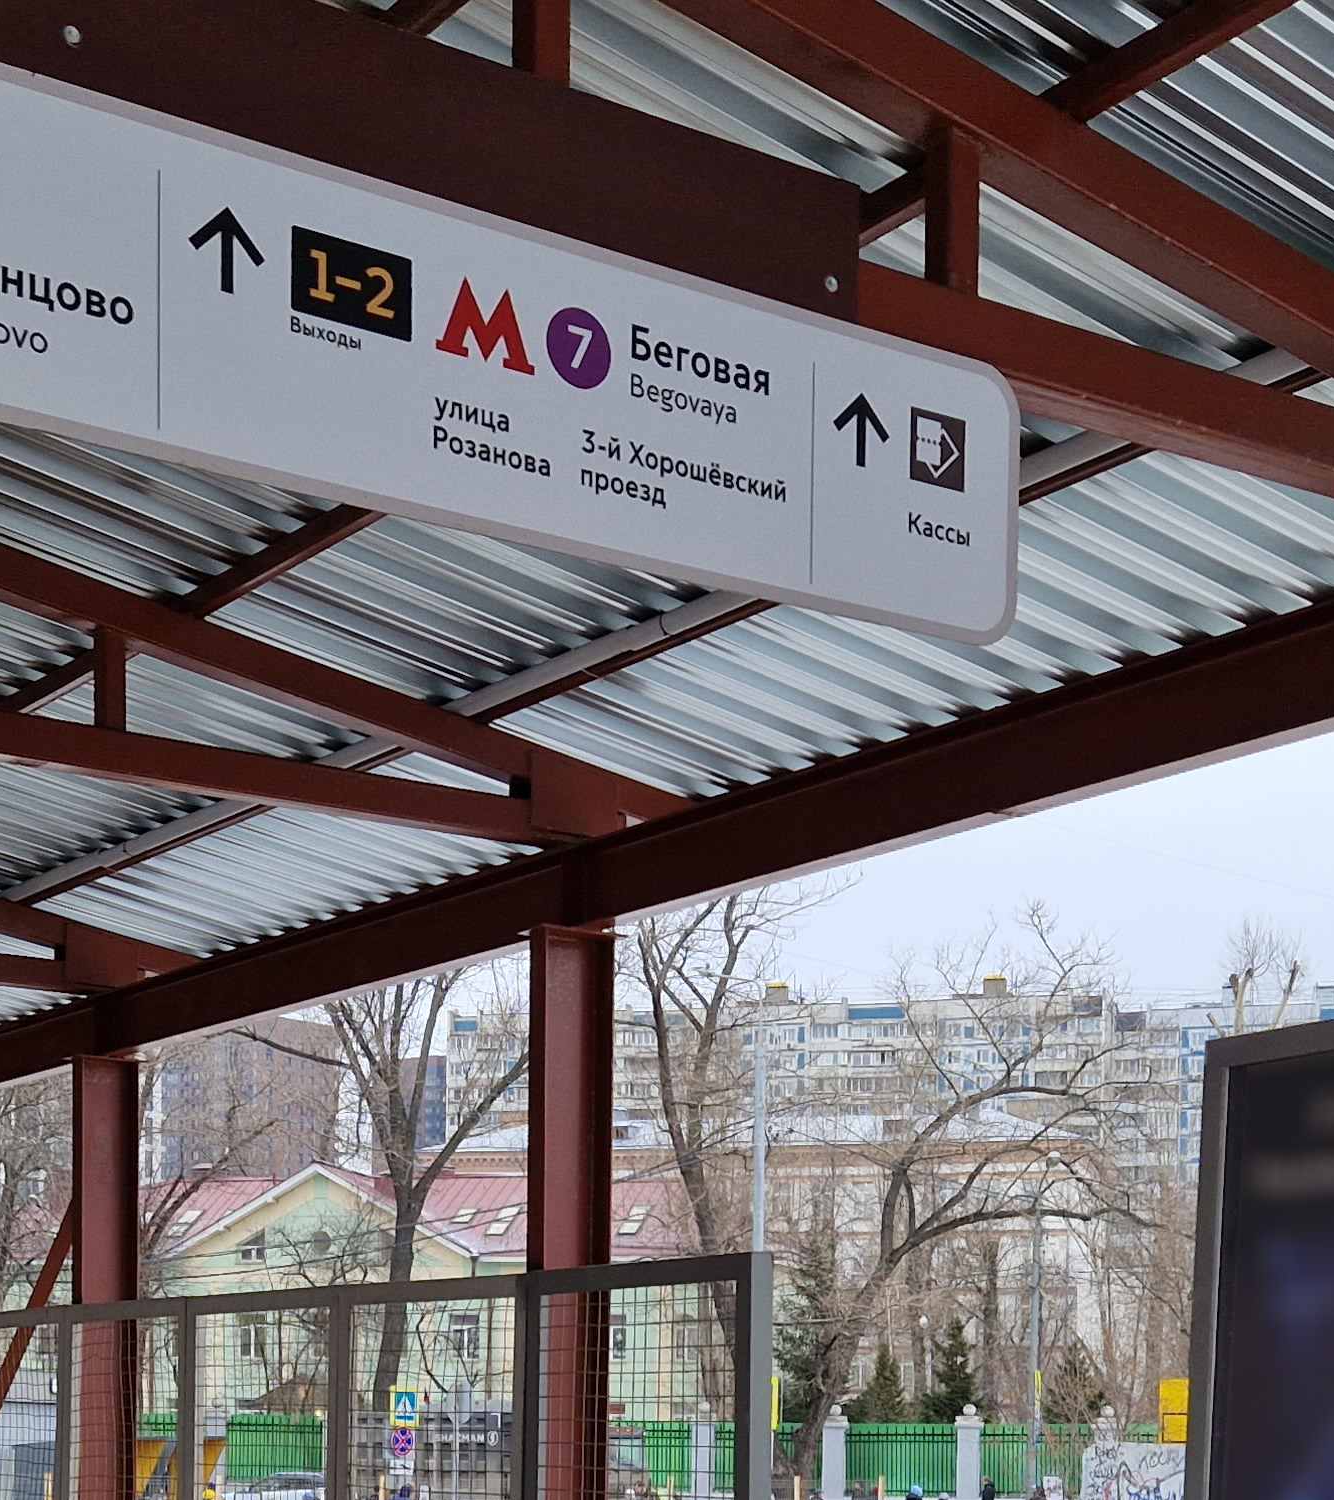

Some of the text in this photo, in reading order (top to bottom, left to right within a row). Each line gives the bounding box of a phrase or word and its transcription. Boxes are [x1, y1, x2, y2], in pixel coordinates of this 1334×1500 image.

[308, 248, 396, 320] 1-2
[290, 314, 362, 351] Выходы
[566, 324, 594, 369] 7
[630, 323, 770, 397] Беговая
[433, 396, 510, 434] улица
[630, 372, 738, 425] Begovaya
[432, 424, 551, 478] Розанова
[581, 428, 787, 504] 3-й Хорошёвский
[580, 468, 667, 510] проезд
[908, 511, 971, 548] Кассы
